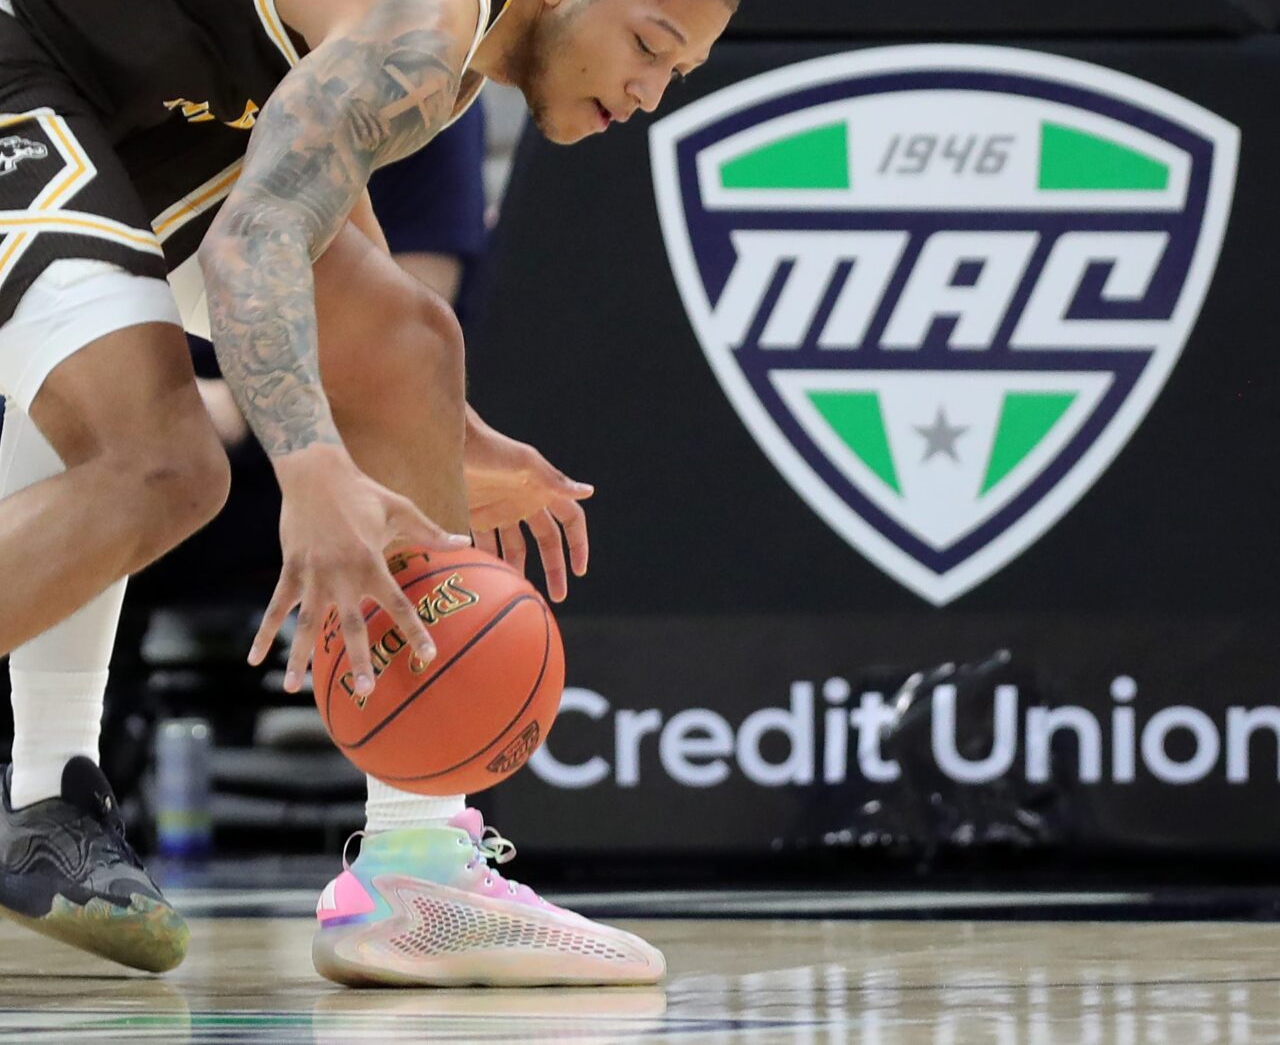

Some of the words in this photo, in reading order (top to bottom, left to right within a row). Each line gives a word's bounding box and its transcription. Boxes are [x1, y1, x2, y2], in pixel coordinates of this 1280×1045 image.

[877, 132, 1017, 177] 1946
[715, 228, 1174, 350] MAC
[528, 674, 902, 789] Credit
[932, 673, 1280, 785] Union
